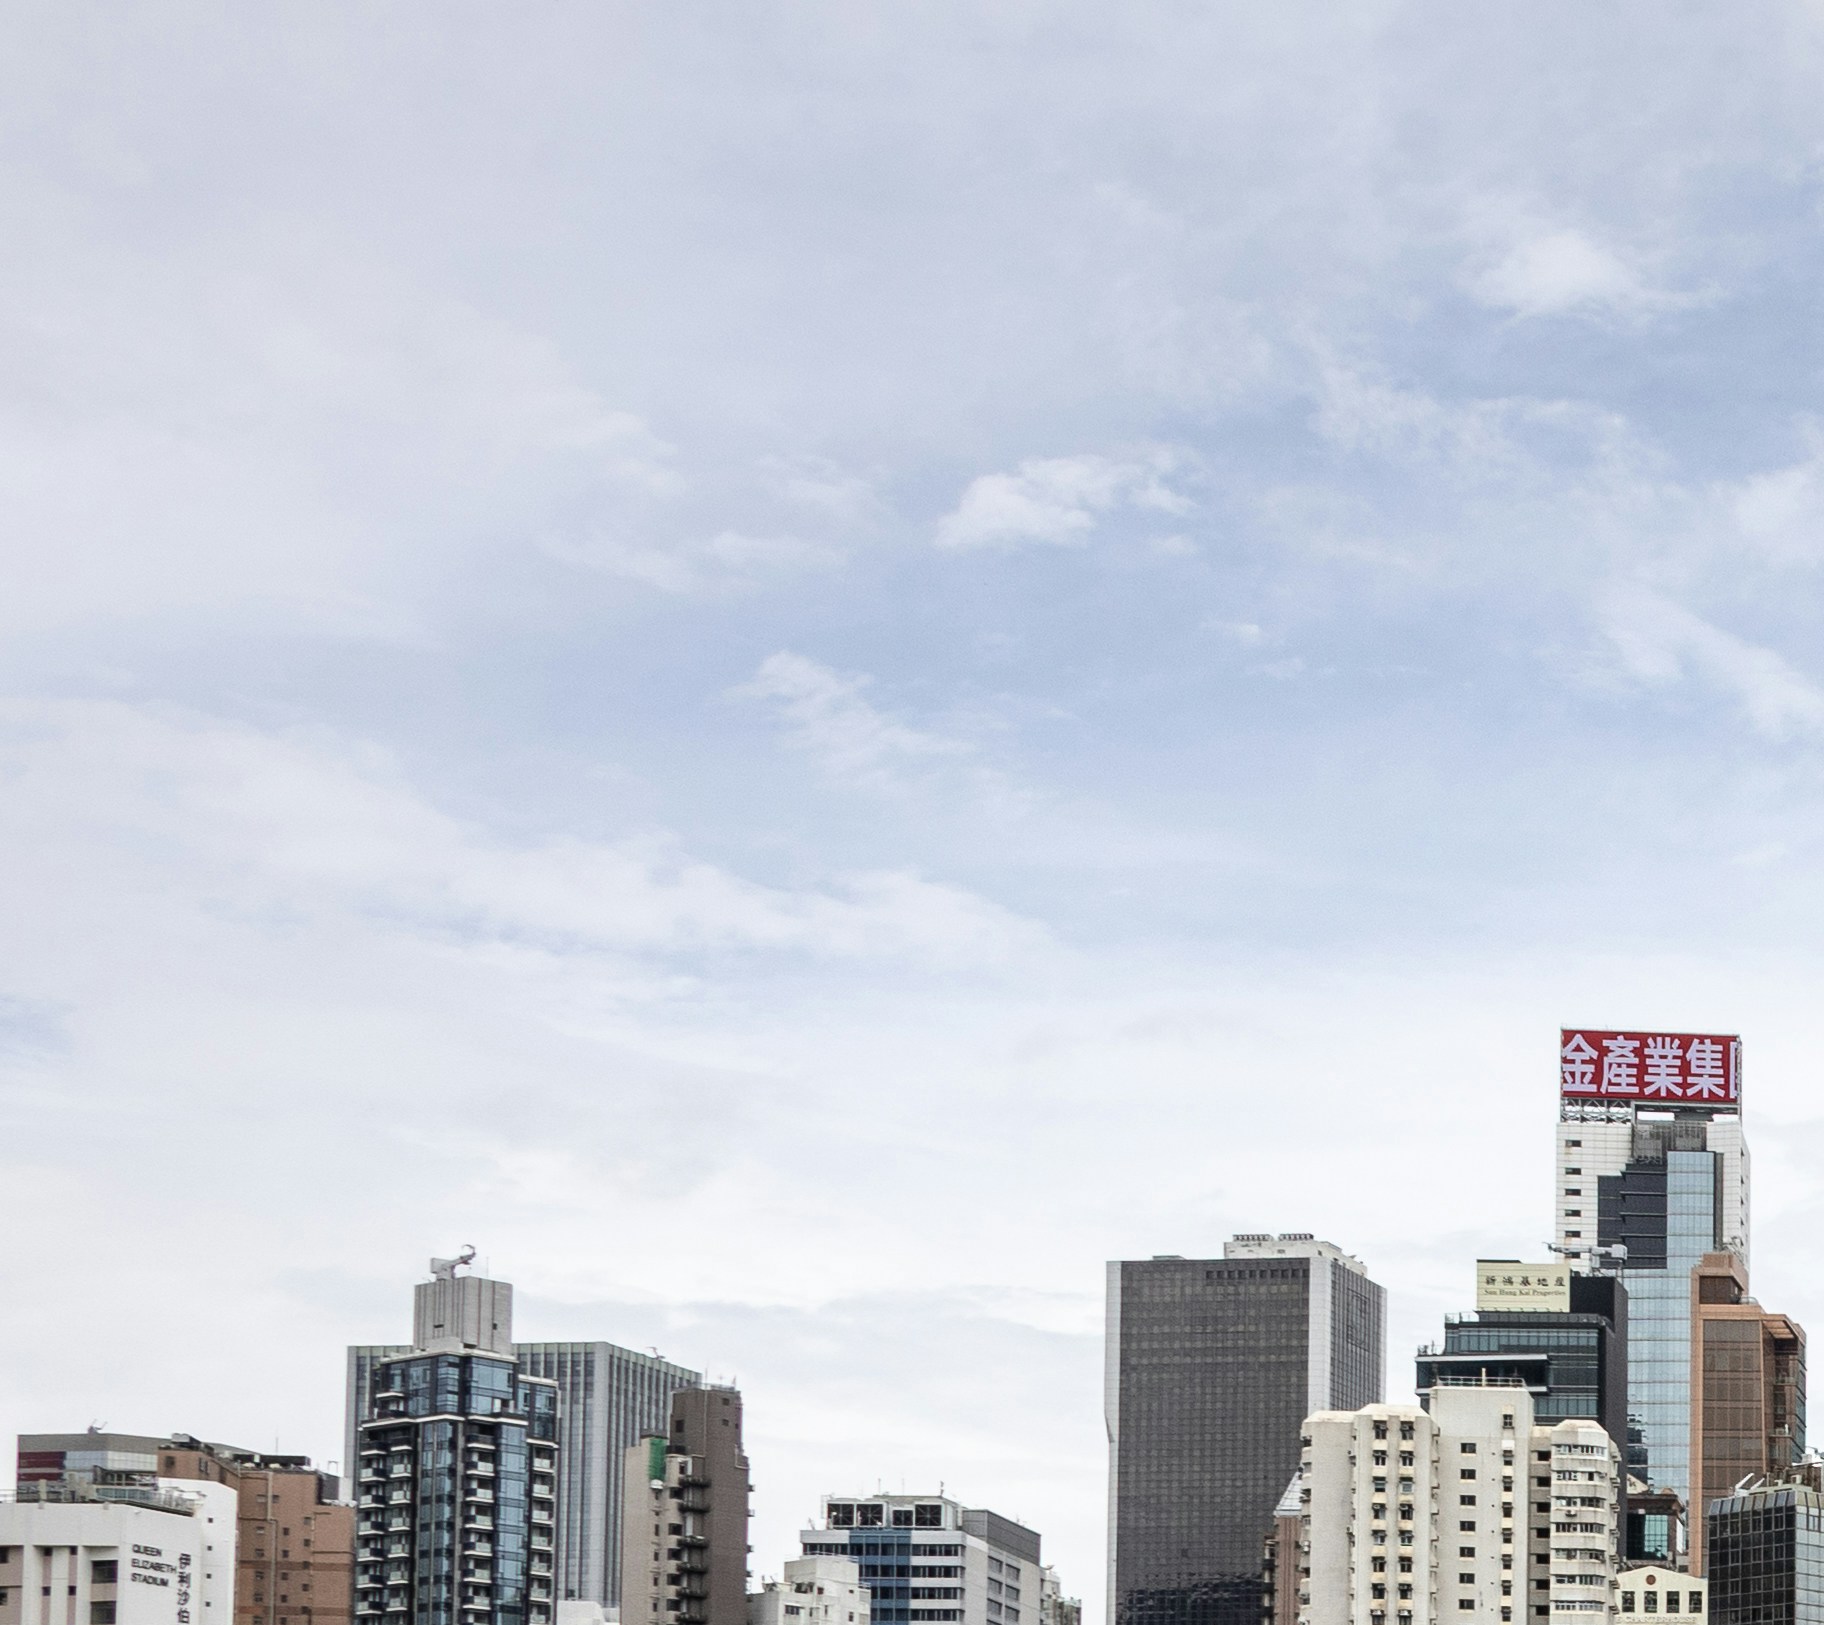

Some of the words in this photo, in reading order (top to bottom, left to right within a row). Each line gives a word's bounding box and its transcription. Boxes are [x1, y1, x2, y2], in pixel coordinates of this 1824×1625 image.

[1562, 1033, 1738, 1099] 金產業集
[1532, 1289, 1566, 1297] Properties
[132, 1544, 162, 1557] QUEEN
[131, 1558, 177, 1574] ELIZABETH
[131, 1573, 169, 1587] STADIUM
